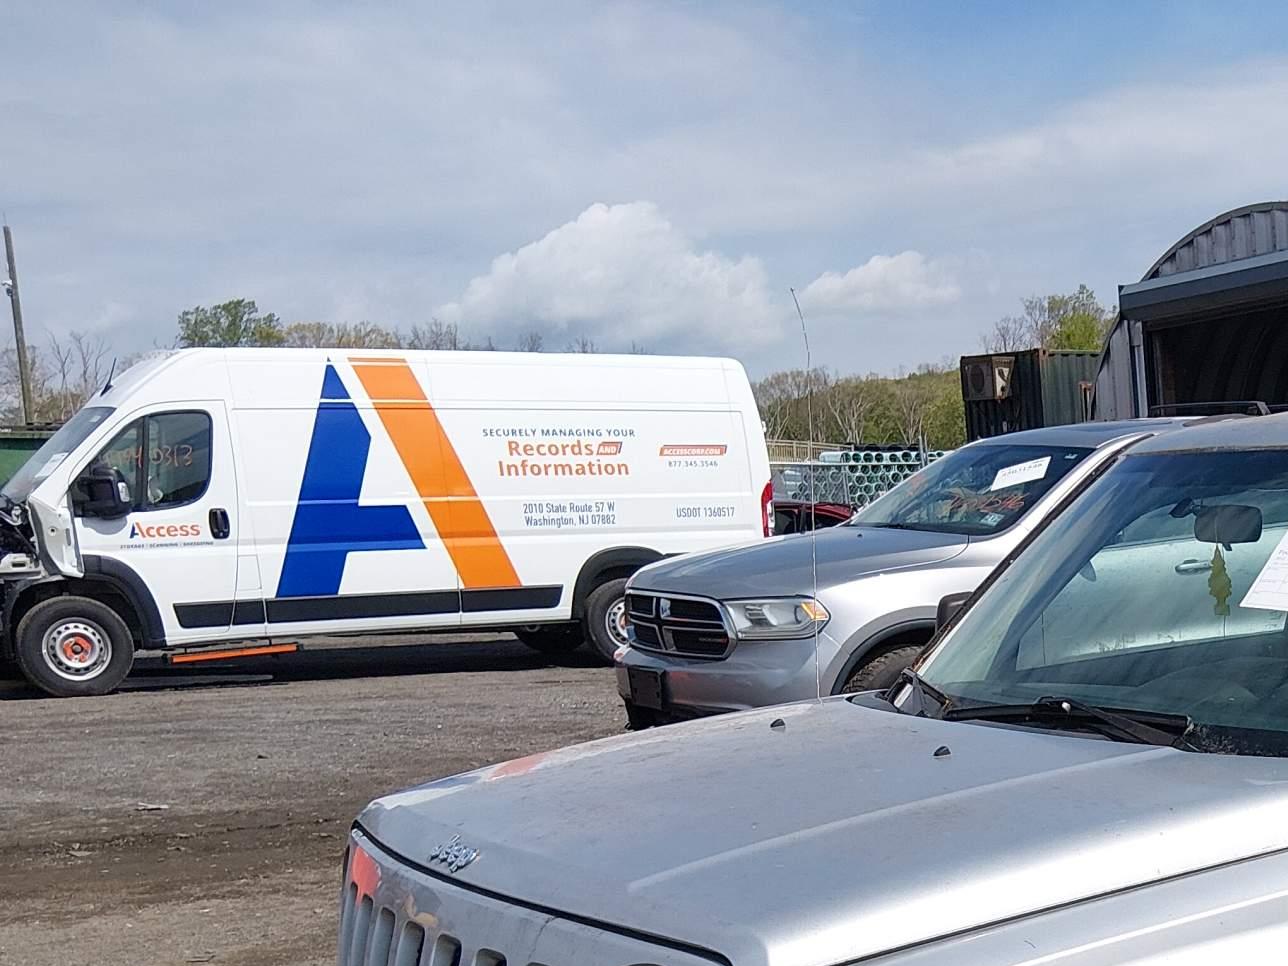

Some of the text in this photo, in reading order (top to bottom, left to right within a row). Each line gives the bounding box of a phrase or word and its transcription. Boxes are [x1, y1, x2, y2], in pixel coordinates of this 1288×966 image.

[482, 428, 635, 437] SECURELY MANAGING YOUR
[507, 440, 617, 456] Records AND
[498, 459, 630, 477] Information
[523, 500, 615, 514] 2010 State Route 57 W
[676, 506, 735, 518] USDOT 1360517
[524, 513, 616, 529] Washington, NJ 07882
[129, 521, 201, 539] Access
